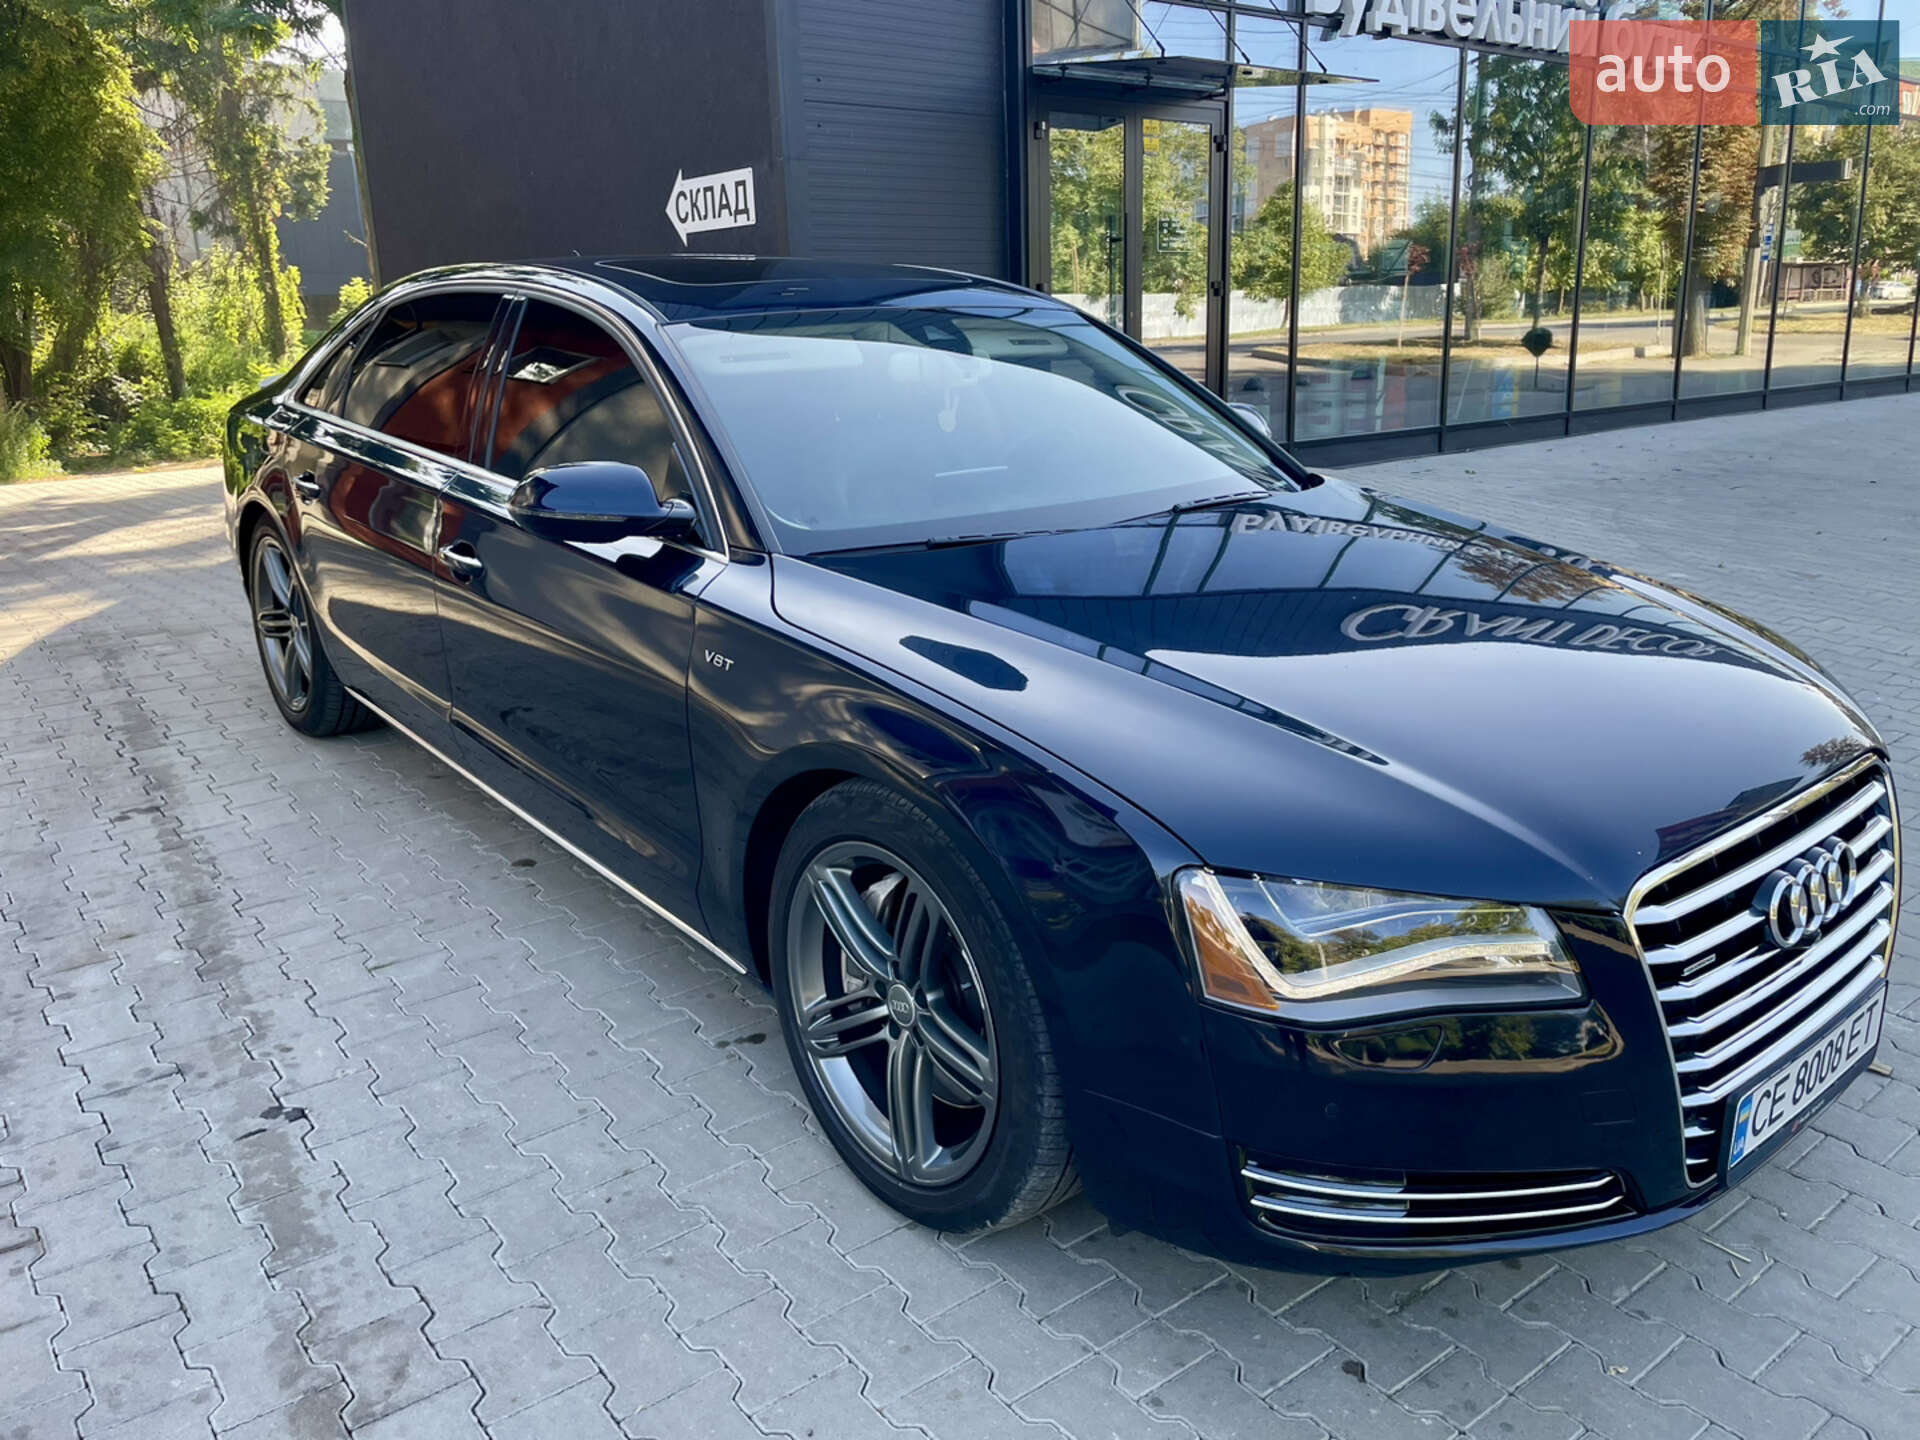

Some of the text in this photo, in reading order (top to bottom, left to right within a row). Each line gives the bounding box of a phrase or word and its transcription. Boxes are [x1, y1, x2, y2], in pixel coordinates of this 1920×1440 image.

[1304, 0, 1600, 56] удівельний
[676, 180, 750, 223] СКЛАД
[1752, 1074, 1790, 1137] CE
[1792, 1030, 1845, 1105] 8008
[1846, 1000, 1878, 1061] ET
